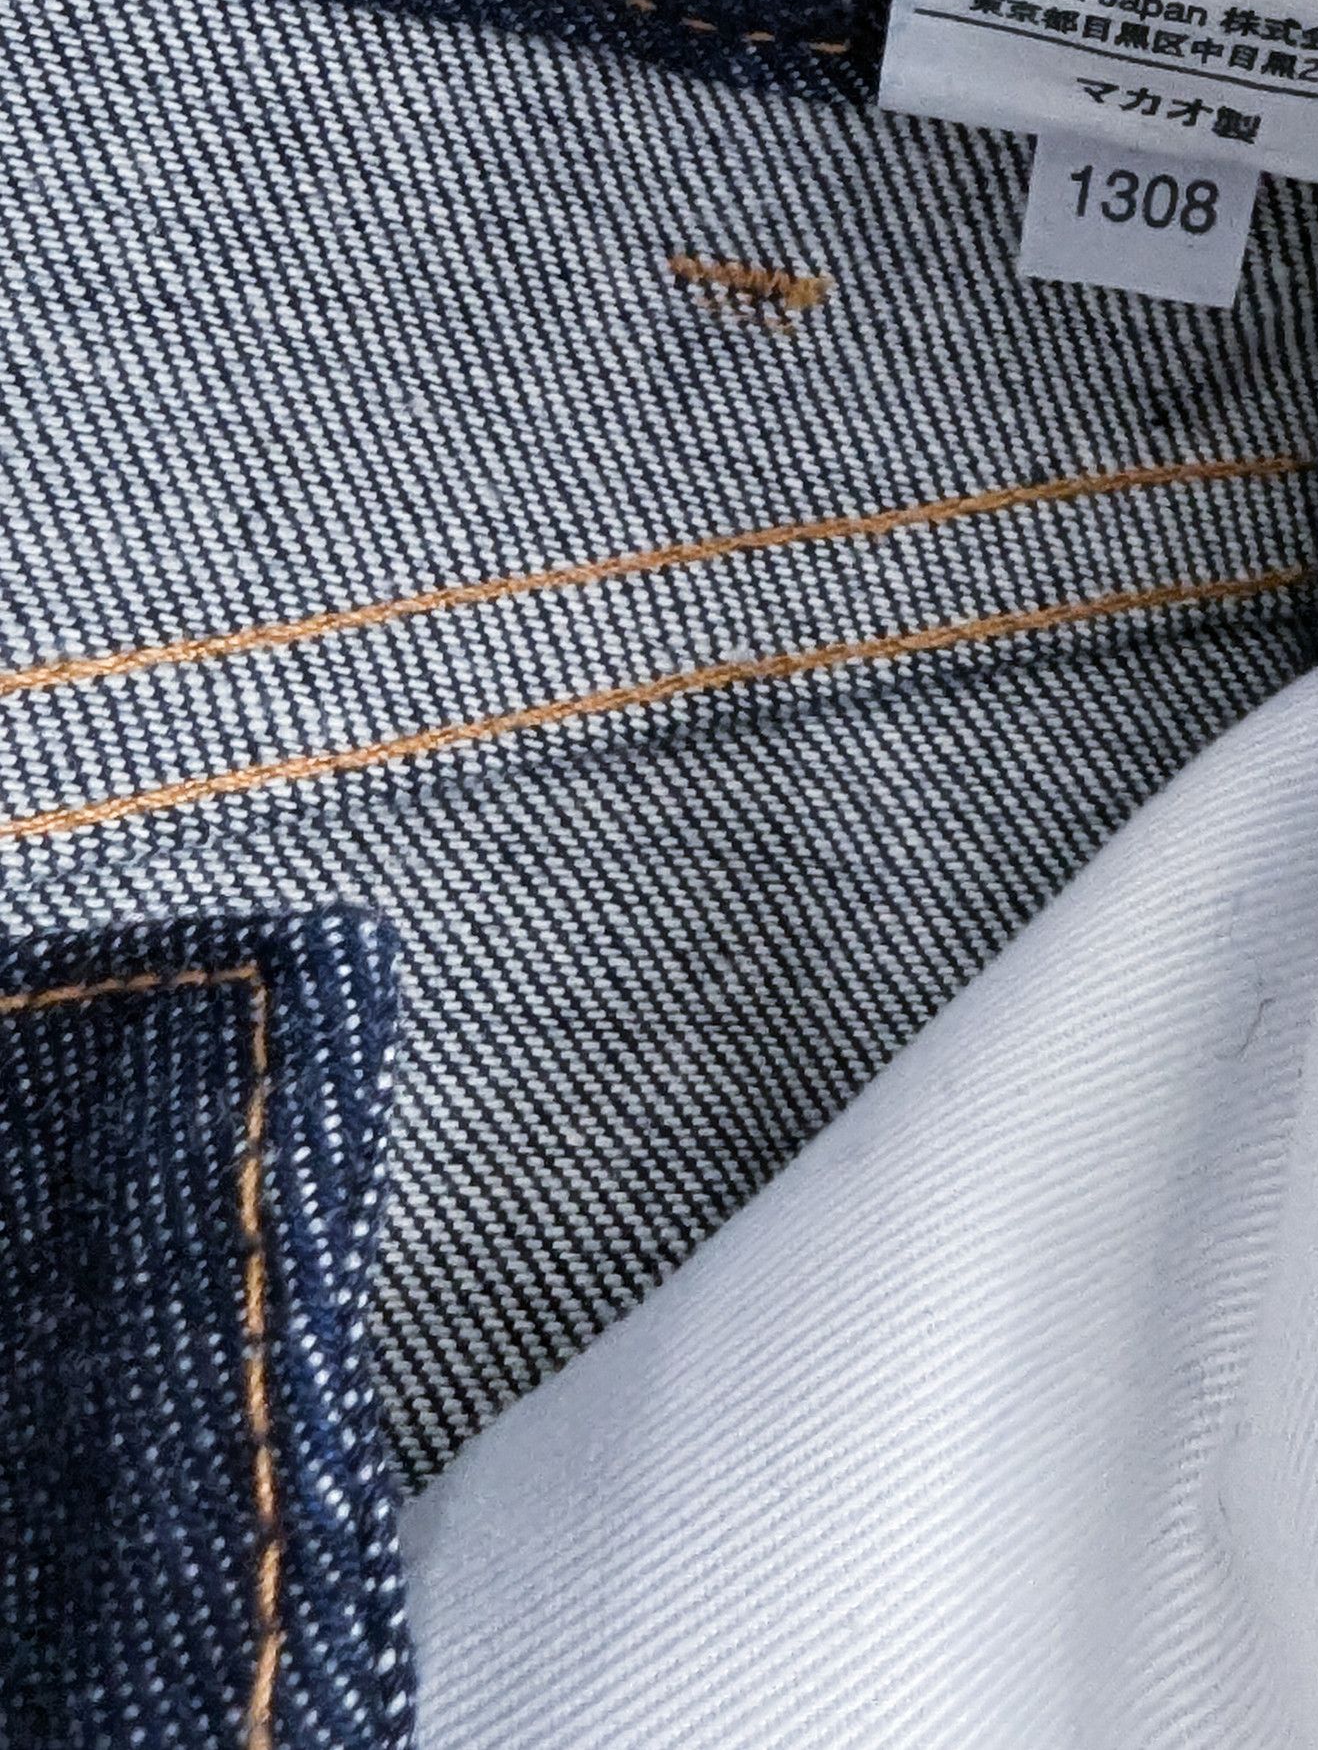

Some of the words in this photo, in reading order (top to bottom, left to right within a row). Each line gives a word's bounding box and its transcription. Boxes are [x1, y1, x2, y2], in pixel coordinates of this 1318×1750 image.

[1076, 77, 1262, 145] マカオ製
[1071, 166, 1220, 235] 1308
